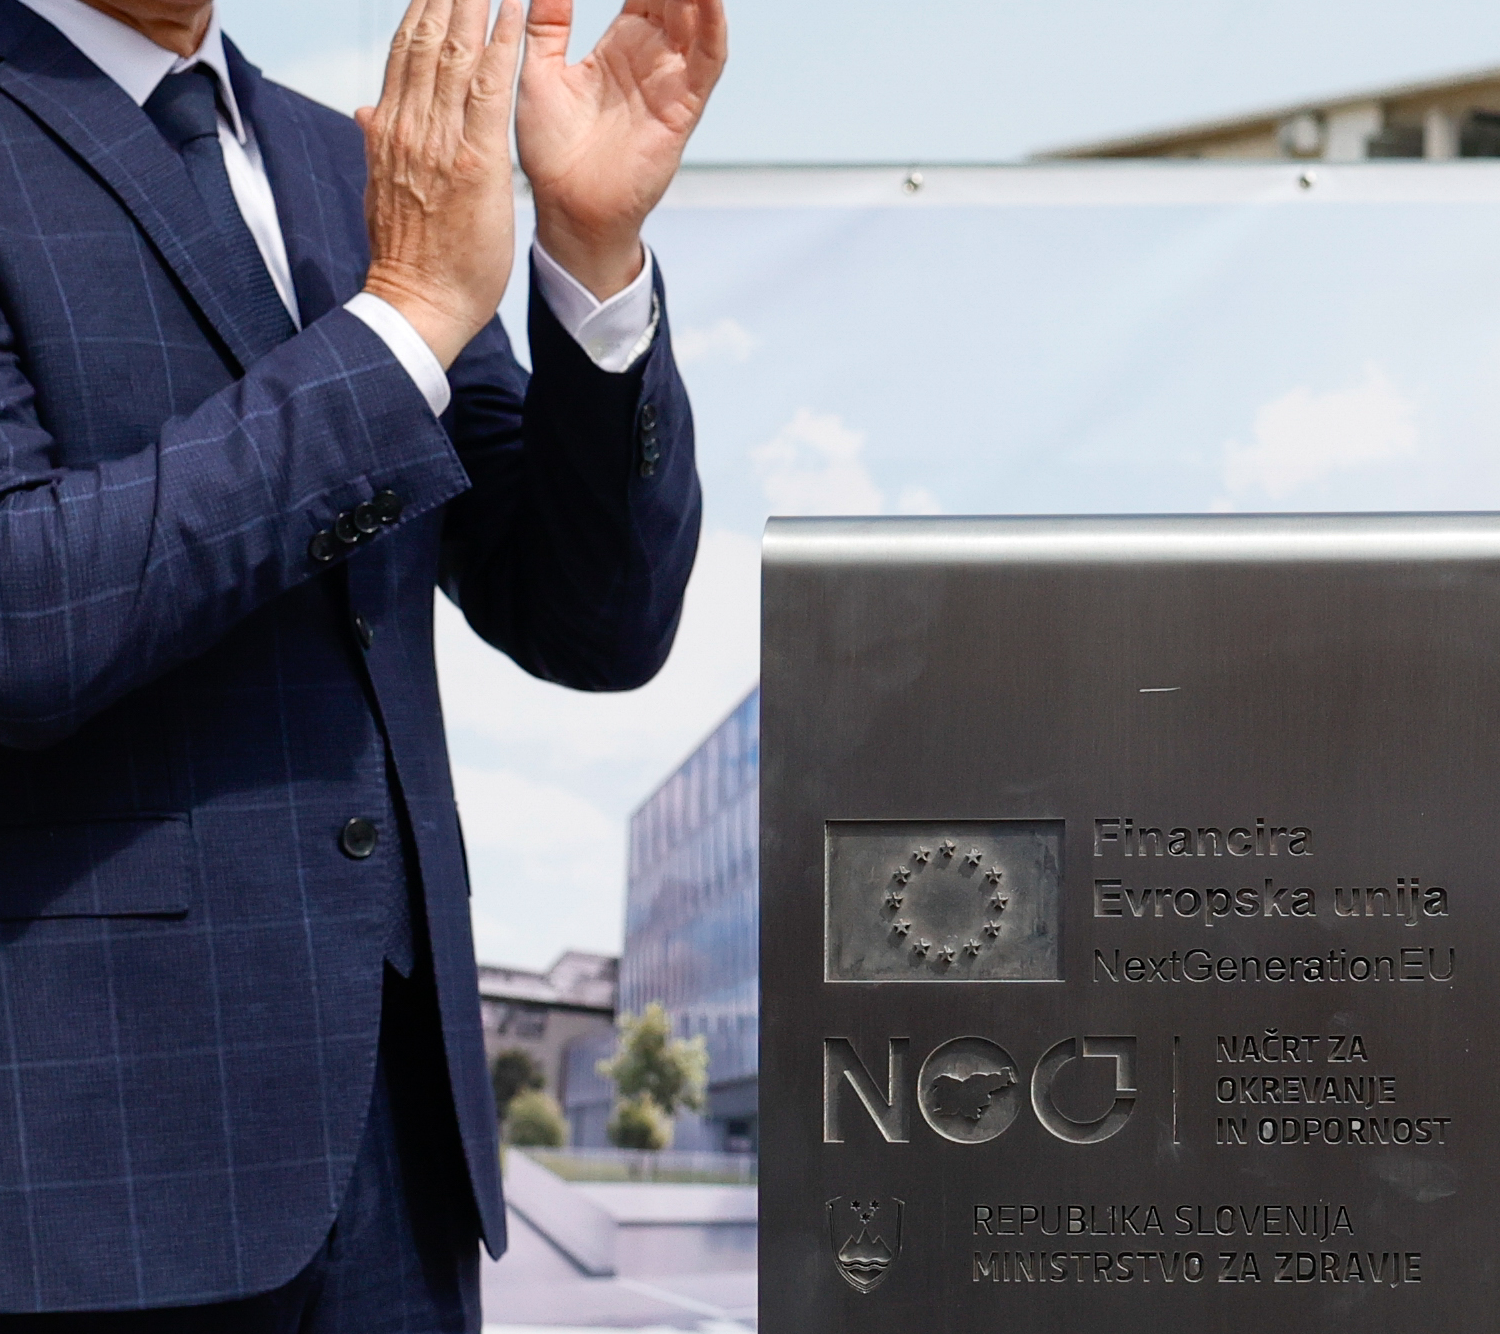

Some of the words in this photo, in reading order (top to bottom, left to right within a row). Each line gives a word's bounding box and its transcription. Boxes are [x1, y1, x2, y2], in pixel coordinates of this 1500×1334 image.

[1093, 817, 1315, 857] Financira
[1093, 877, 1317, 928] Evropska
[1333, 877, 1450, 928] unija
[1093, 947, 1455, 983] NextGenerationEU
[1216, 1027, 1321, 1064] NAČRT
[1326, 1035, 1369, 1064] ZA
[1215, 1075, 1397, 1111] OKREVANJE
[1215, 1117, 1248, 1145] IN
[1256, 1117, 1452, 1145] ODPORNOST
[972, 1204, 1165, 1236] REPUBLIKA
[1174, 1203, 1355, 1243] SLOVENIJA
[972, 1251, 1205, 1283] MINISTRSTVO
[1217, 1251, 1262, 1283] ZA
[1272, 1251, 1423, 1289] ZDRAVJE
